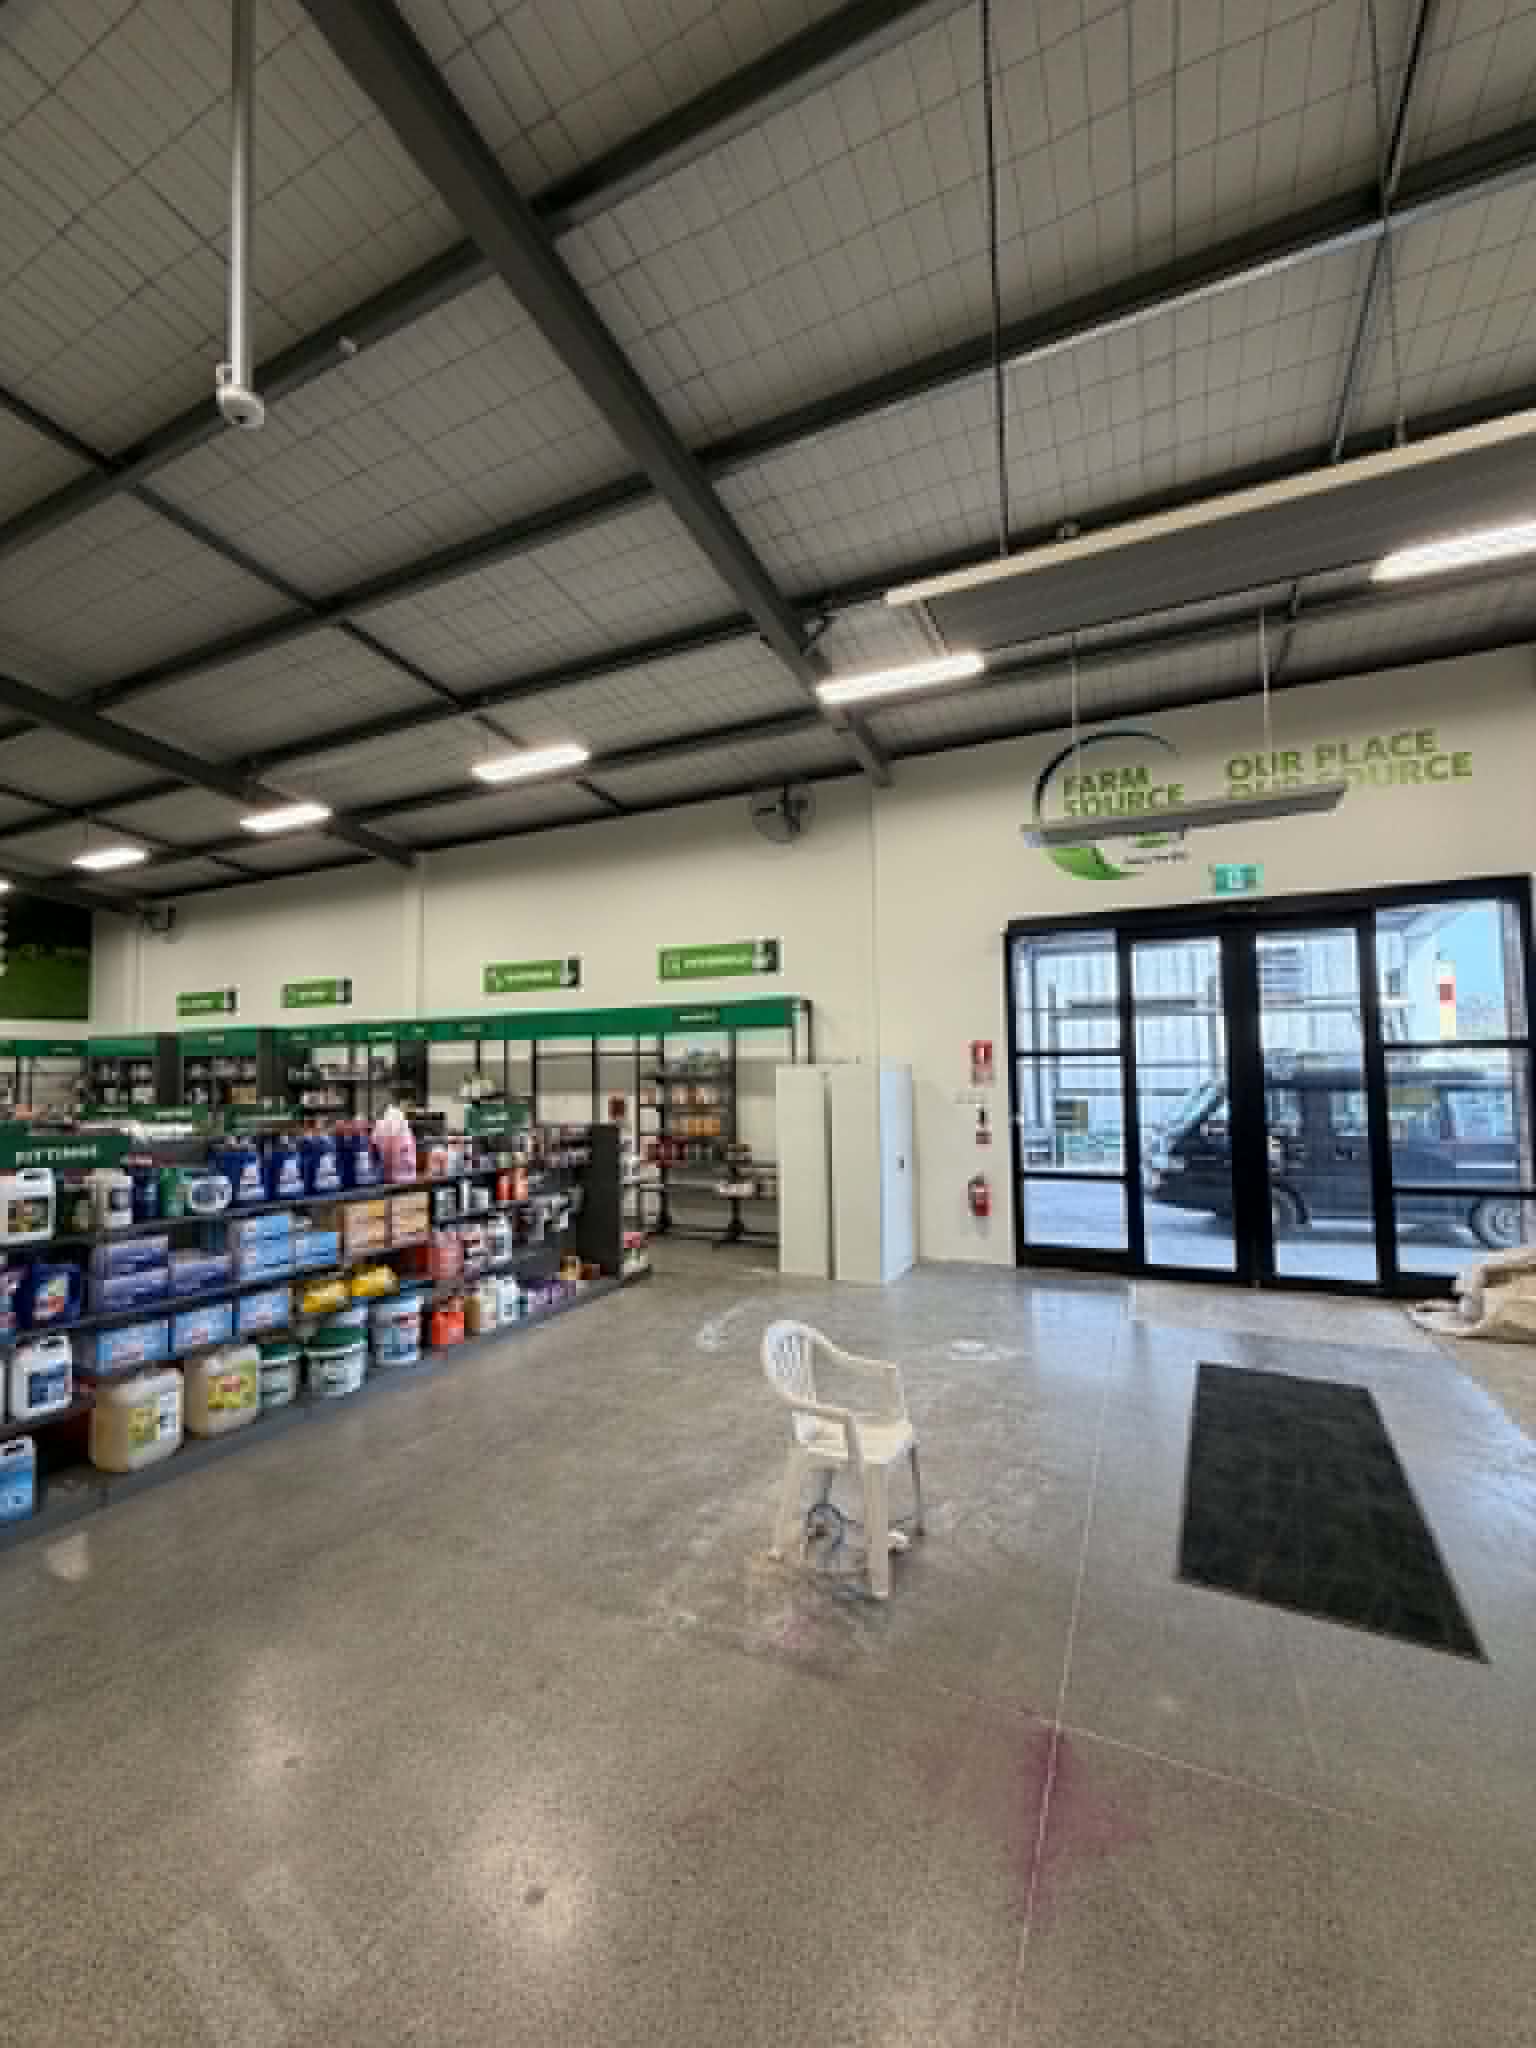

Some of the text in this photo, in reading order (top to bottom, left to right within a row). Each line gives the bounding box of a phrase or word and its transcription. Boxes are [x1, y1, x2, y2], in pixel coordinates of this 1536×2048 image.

[1224, 729, 1437, 782] OUR PLACE
[1062, 764, 1152, 798] FARM
[1063, 783, 1184, 819] SOURCE
